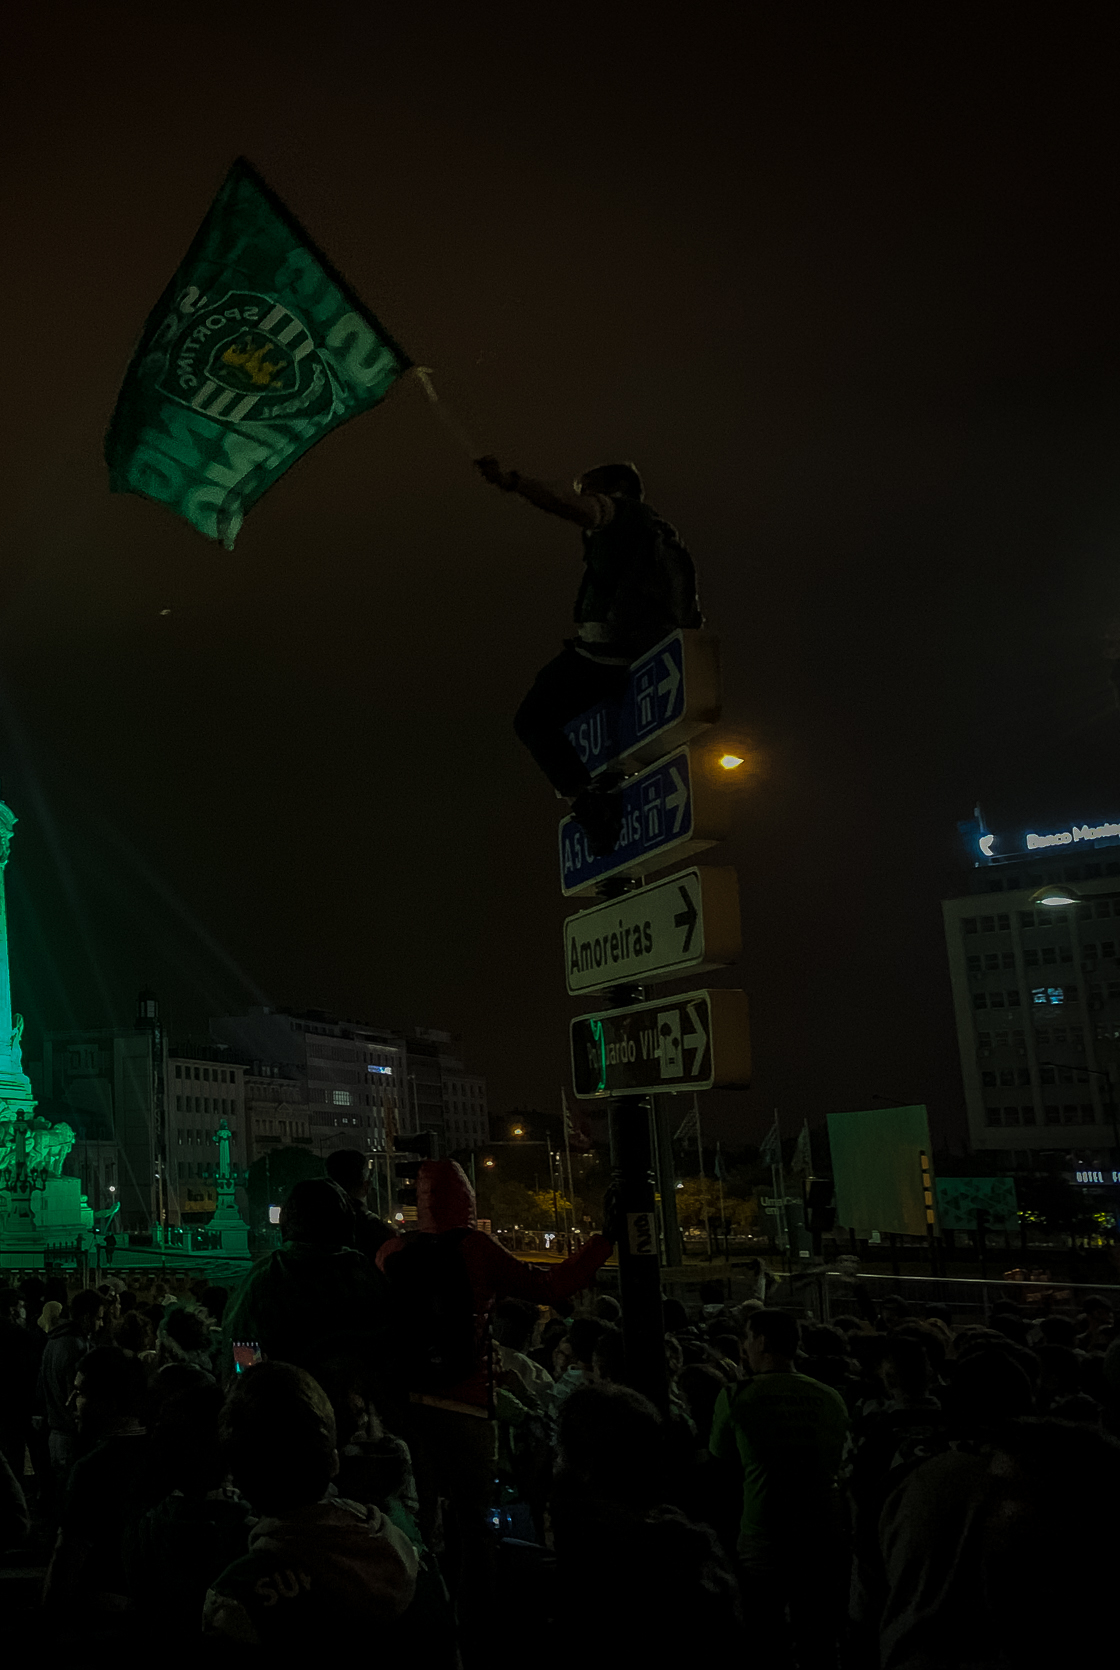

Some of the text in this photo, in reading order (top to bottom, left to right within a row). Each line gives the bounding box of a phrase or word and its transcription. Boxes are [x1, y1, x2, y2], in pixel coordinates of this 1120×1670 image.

[564, 832, 582, 874] A5
[1026, 832, 1072, 850] Banco
[570, 919, 653, 975] Amoreiras
